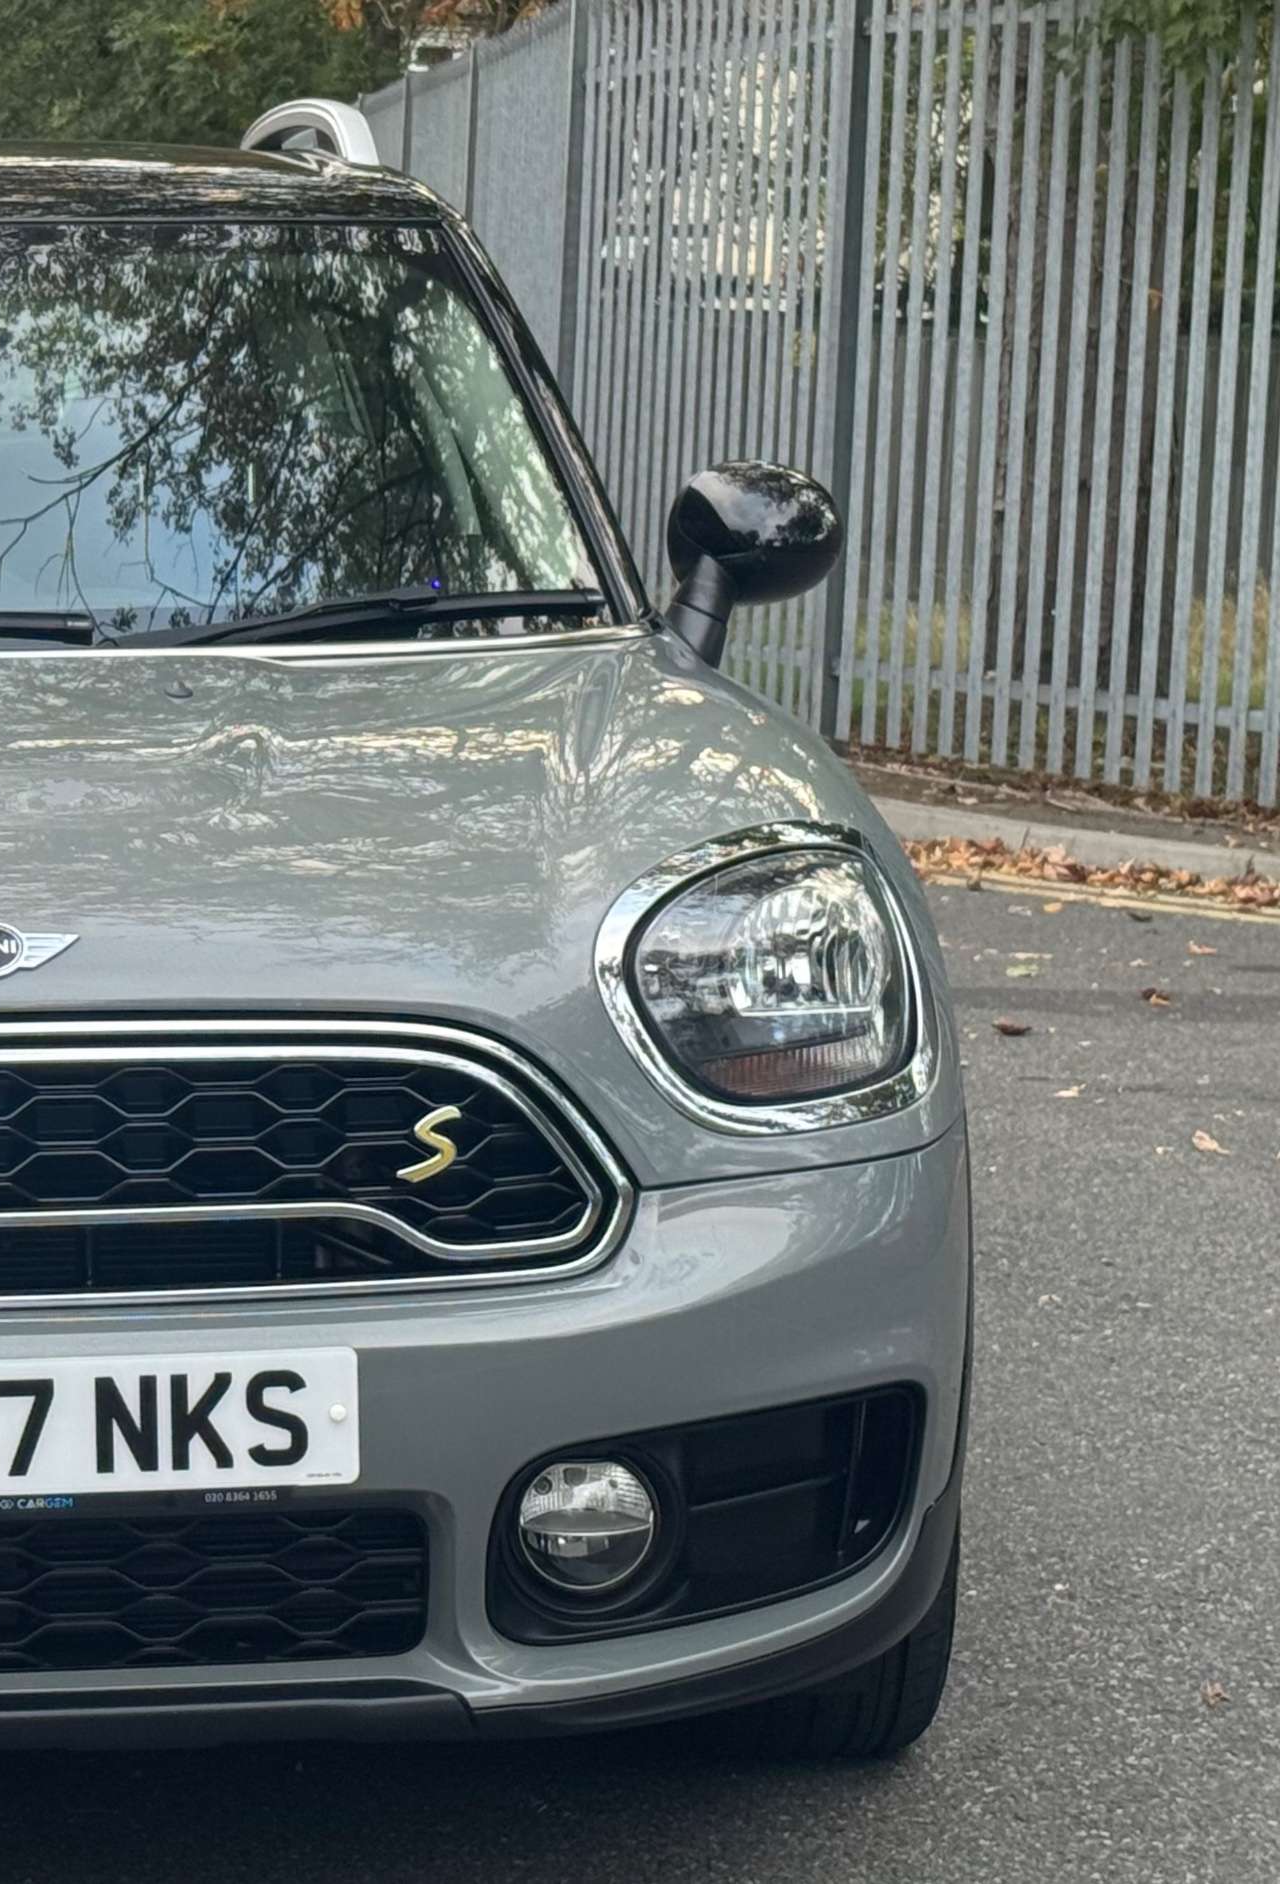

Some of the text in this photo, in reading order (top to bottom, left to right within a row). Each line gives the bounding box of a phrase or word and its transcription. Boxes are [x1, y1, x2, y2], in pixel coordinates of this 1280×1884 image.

[396, 1105, 461, 1183] S
[94, 1369, 309, 1474] NKS
[17, 1497, 73, 1510] CARGEM
